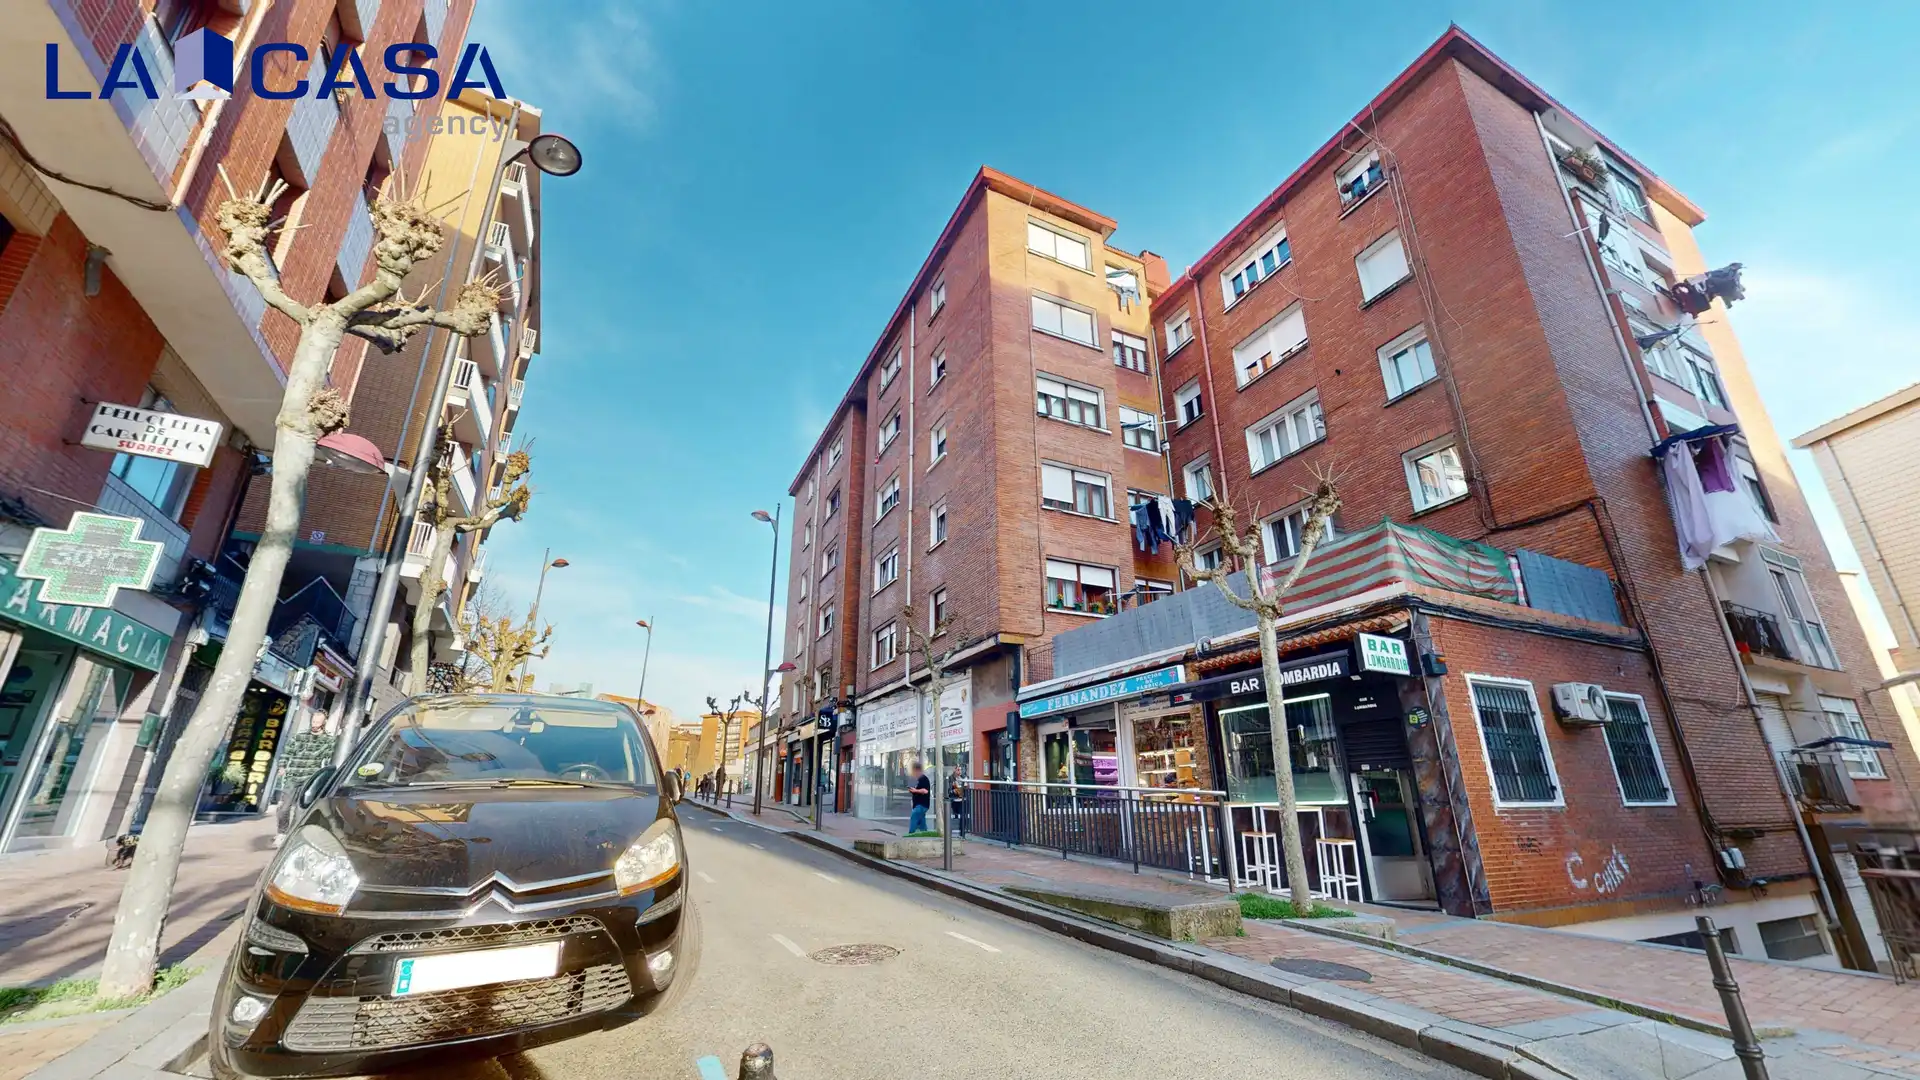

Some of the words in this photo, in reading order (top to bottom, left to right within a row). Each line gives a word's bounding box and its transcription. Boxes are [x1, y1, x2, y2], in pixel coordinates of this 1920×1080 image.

[145, 425, 167, 436] DE
[117, 440, 175, 456] SUAREZ
[0, 565, 162, 666] ARMACIA
[1367, 639, 1402, 655] BAR
[1367, 653, 1409, 671] LOMBARDIA
[1230, 678, 1260, 694] BAR
[1279, 662, 1342, 686] OMBARDIA
[1047, 682, 1128, 710] FERNANDEZ
